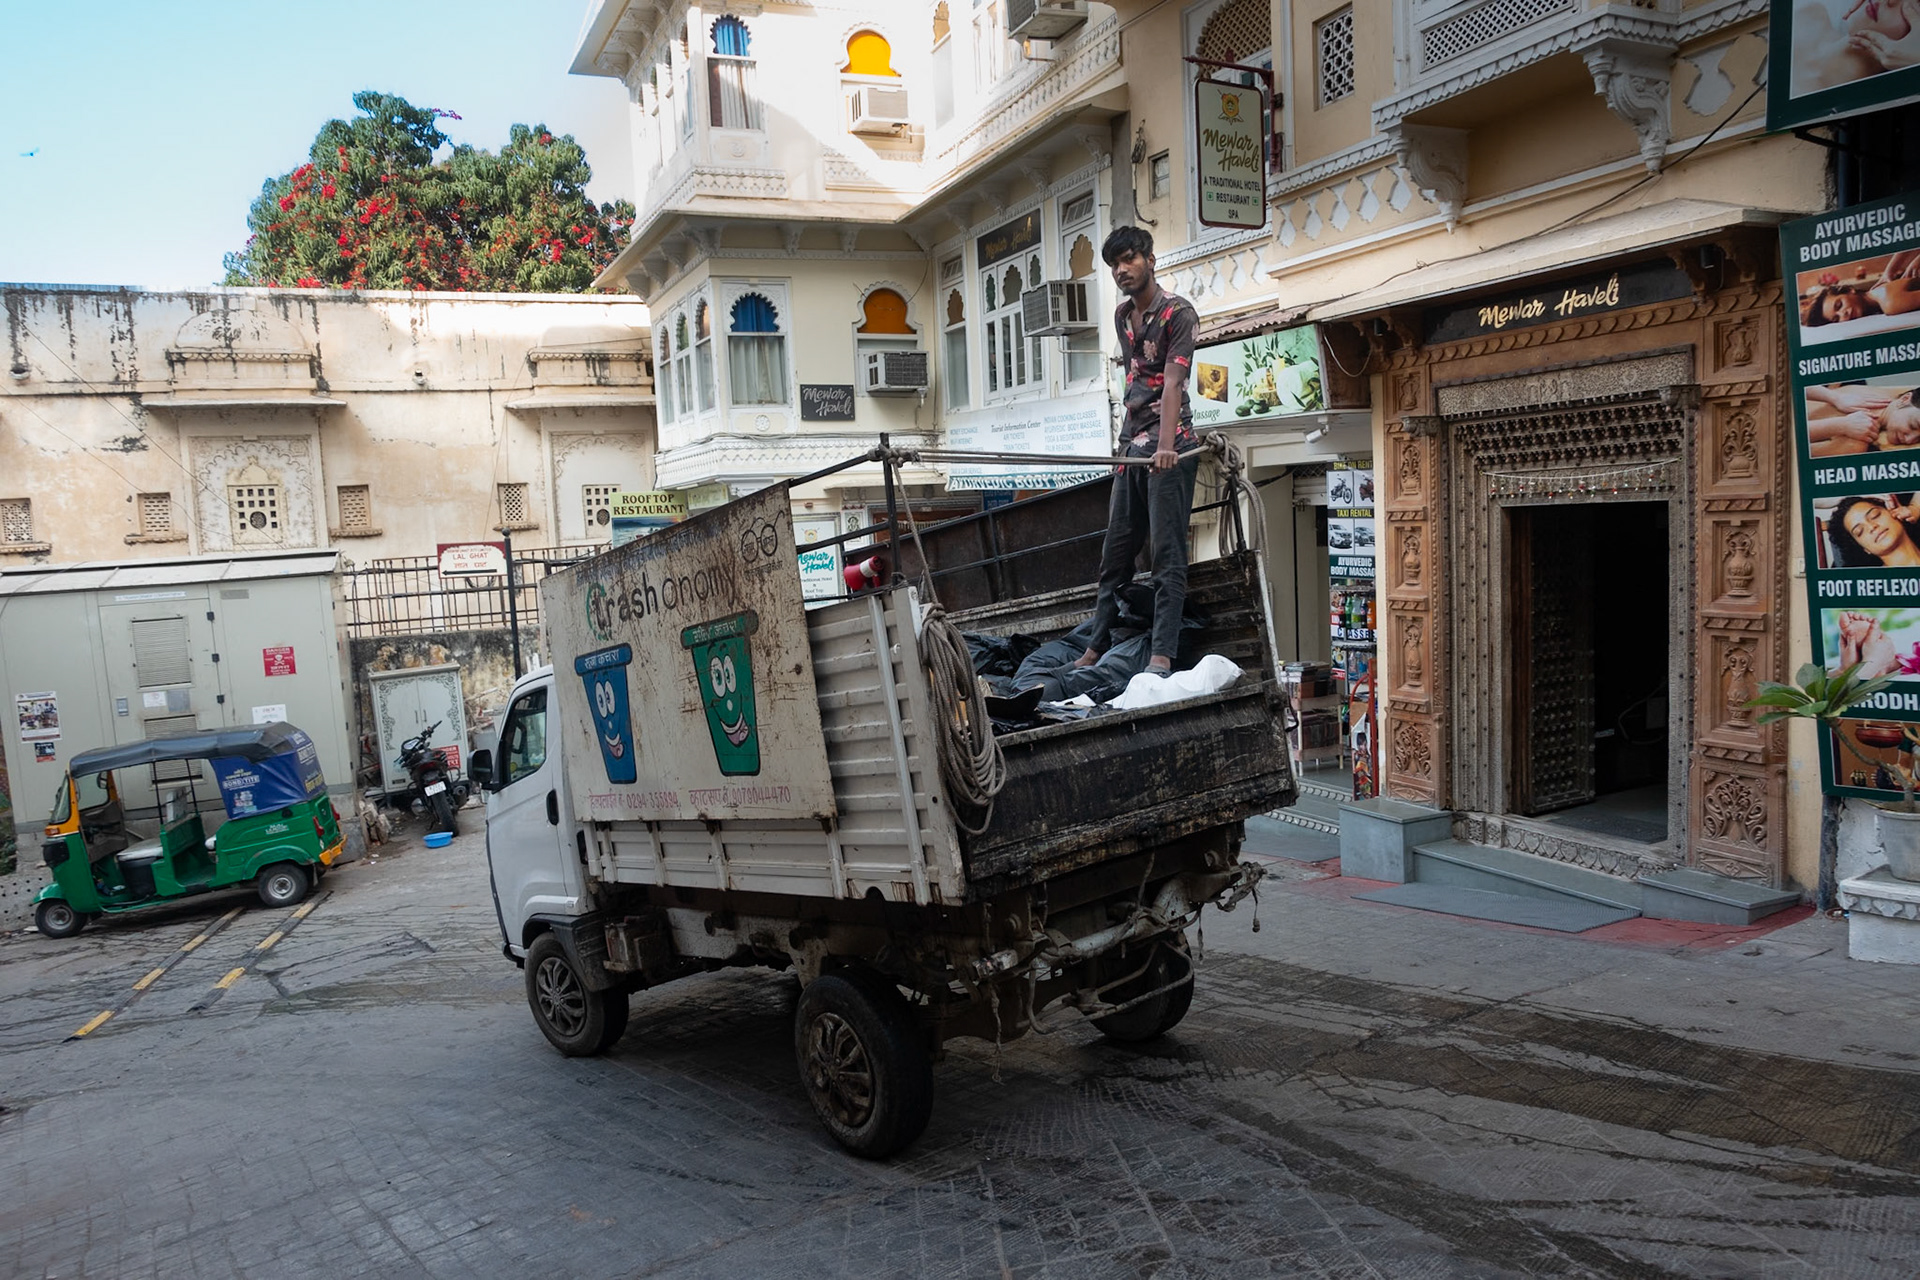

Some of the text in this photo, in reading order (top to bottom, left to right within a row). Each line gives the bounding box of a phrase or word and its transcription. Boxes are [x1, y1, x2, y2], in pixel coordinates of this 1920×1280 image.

[1203, 128, 1253, 152] Mewar
[1218, 145, 1259, 173] Haveli
[1204, 176, 1261, 192] A TRADITIONAL HOTEL
[1216, 193, 1250, 206] RESTAURANT
[1228, 210, 1239, 219] SPA
[1815, 204, 1906, 240] AYURVEDIC
[1800, 239, 1841, 263] BODY
[1478, 272, 1619, 329] Mewar Haveli
[1799, 350, 1872, 376] SIGNATURE
[803, 387, 847, 403] Mewar
[816, 396, 852, 416] Haveli
[1004, 422, 1026, 431] Information
[1334, 461, 1346, 470] BIKE
[1358, 461, 1373, 469] RENT
[1814, 461, 1920, 485] HEAD MASSA
[951, 476, 1013, 490] AYURVEDIC
[1014, 474, 1051, 488] BODY
[613, 504, 685, 516] RESTAURANT
[1337, 509, 1372, 517] TAXI RENTAL
[803, 556, 835, 574] Haveli
[1338, 557, 1372, 566] AYURVEDIC
[1331, 567, 1347, 575] BODY
[1818, 580, 1852, 597] FOOT
